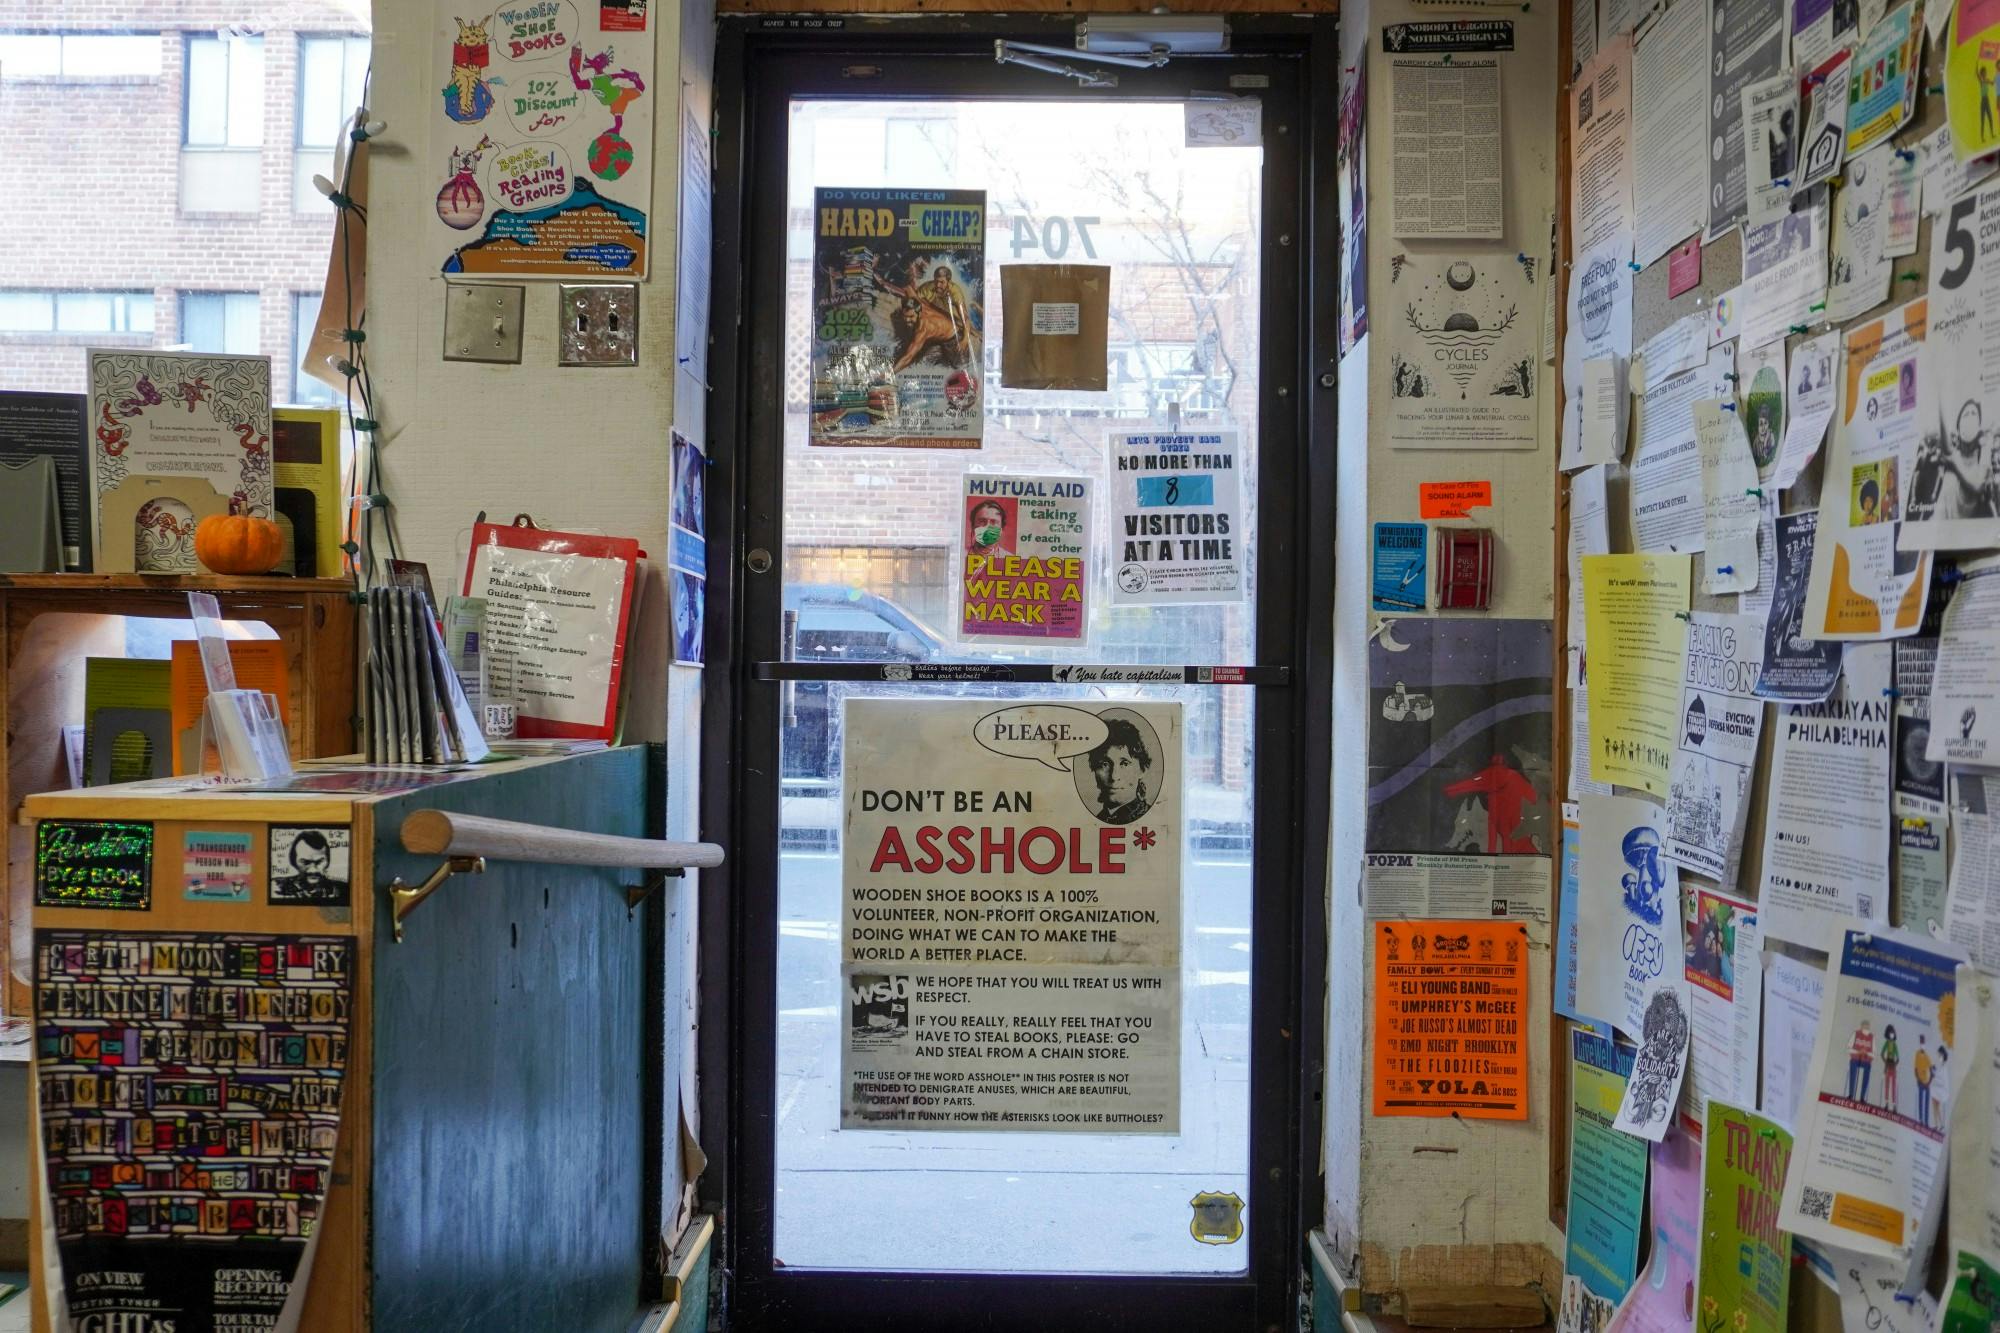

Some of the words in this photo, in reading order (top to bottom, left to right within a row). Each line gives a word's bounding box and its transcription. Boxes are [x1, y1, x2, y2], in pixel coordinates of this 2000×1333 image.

[509, 32, 566, 58] BOOKS
[1456, 33, 1506, 42] FORGIVEN
[528, 80, 558, 96] 10%
[529, 113, 564, 131] for
[824, 191, 844, 200] DO
[851, 191, 880, 200] YOU
[820, 208, 895, 237] HARD
[922, 209, 980, 237] CHEAP?
[1939, 196, 1977, 290] 5
[1596, 258, 1616, 278] FOOD
[825, 309, 870, 324] 10%
[819, 325, 873, 341] OFF!
[1435, 349, 1489, 361] CYCLES
[908, 438, 924, 447] and
[926, 439, 950, 448] phone
[952, 439, 978, 448] orders
[1119, 456, 1138, 470] NO
[1145, 455, 1188, 469] MORE
[1193, 454, 1232, 469] THAN
[970, 480, 1047, 496] MUTUAL
[1052, 483, 1084, 498] AID
[1166, 477, 1178, 506] 8
[1020, 499, 1056, 507] means
[1031, 509, 1077, 523] taking
[1125, 514, 1230, 536] VISITORS
[1021, 533, 1032, 542] of
[1035, 534, 1060, 543] each
[1378, 536, 1422, 548] WELCOME
[1050, 544, 1082, 553] other
[1124, 540, 1151, 562] AT
[1159, 540, 1173, 561] A
[1180, 539, 1232, 560] TIME
[967, 554, 1080, 579] PLEASE
[965, 580, 1050, 600] WEAR
[1061, 582, 1081, 601] A
[965, 602, 1044, 623] MASK
[1075, 668, 1097, 681] You
[1100, 669, 1124, 680] hate
[1125, 669, 1183, 682] capitalism
[1726, 708, 1755, 725] EVICTION
[993, 723, 1090, 741] PLEASE...
[1788, 723, 1887, 749] PHILADELPHIA
[862, 790, 944, 812] DON'T
[954, 790, 983, 812] BE
[992, 791, 1032, 812] AN
[1775, 832, 1794, 843] JOIN
[1796, 835, 1810, 845] US!
[1368, 855, 1413, 867] FOPM
[1771, 875, 1792, 888] READ
[1794, 880, 1812, 892] OUR
[1816, 884, 1839, 897] ZINE!
[852, 888, 921, 901] WOODEN
[926, 889, 965, 901] SHOE
[971, 890, 1022, 902] BOOKS
[1027, 890, 1039, 902] IS
[1044, 890, 1054, 902] A
[1061, 890, 1098, 903] 100%
[852, 908, 939, 922] VOLUNTEER,
[944, 909, 1035, 922] NON-PROFIT
[1039, 910, 1160, 924] ORGANIZATION,
[852, 928, 904, 940] DOING
[909, 929, 951, 941] WHAT
[955, 929, 976, 941] WE
[982, 929, 1015, 942] CAN
[1020, 930, 1039, 942] TO
[1044, 930, 1086, 942] MAKE
[1091, 930, 1117, 942] THE
[852, 948, 905, 960] WORLD
[910, 948, 920, 960] A
[926, 949, 971, 960] BETTER
[977, 949, 1027, 961] PLACE.
[1401, 981, 1417, 994] ELI
[1421, 981, 1457, 994] YOUNG
[1461, 981, 1490, 994] BAND
[1402, 1000, 1471, 1013] UMPHREY'S
[1476, 1001, 1516, 1014] McGEE
[1400, 1018, 1415, 1033] JOE
[1419, 1018, 1454, 1033] RUSSO'S
[1457, 1019, 1492, 1034] ALMOST
[1495, 1019, 1516, 1034] DEAD
[1400, 1040, 1421, 1052] EMO
[1427, 1040, 1459, 1052] NIGHT
[1465, 1040, 1516, 1054] BROOKLYN
[1400, 1058, 1421, 1072] THE
[1429, 1059, 1489, 1074] FLOOZIES
[1637, 1056, 1681, 1077] SOLIDARITY
[877, 1072, 895, 1080] USE
[898, 1072, 911, 1080] OF
[914, 1072, 930, 1081] THE
[934, 1072, 964, 1081] WORD
[1023, 1074, 1033, 1082] IN
[1036, 1074, 1056, 1082] THIS
[1059, 1074, 1094, 1082] POSTER
[1097, 1074, 1106, 1082] IS
[1109, 1074, 1129, 1082] NOT
[904, 1084, 916, 1092] TO
[920, 1084, 974, 1094] DENIGRATE
[977, 1085, 1018, 1095] ANUSES,
[1021, 1086, 1055, 1094] WHICH
[1058, 1086, 1077, 1094] ARE
[1080, 1086, 1131, 1096] BEAUTIFUL,
[1417, 1080, 1489, 1095] YOLA
[76, 1273, 101, 1286] ON
[104, 1271, 144, 1285] VIEW
[214, 1268, 282, 1281] OPENING
